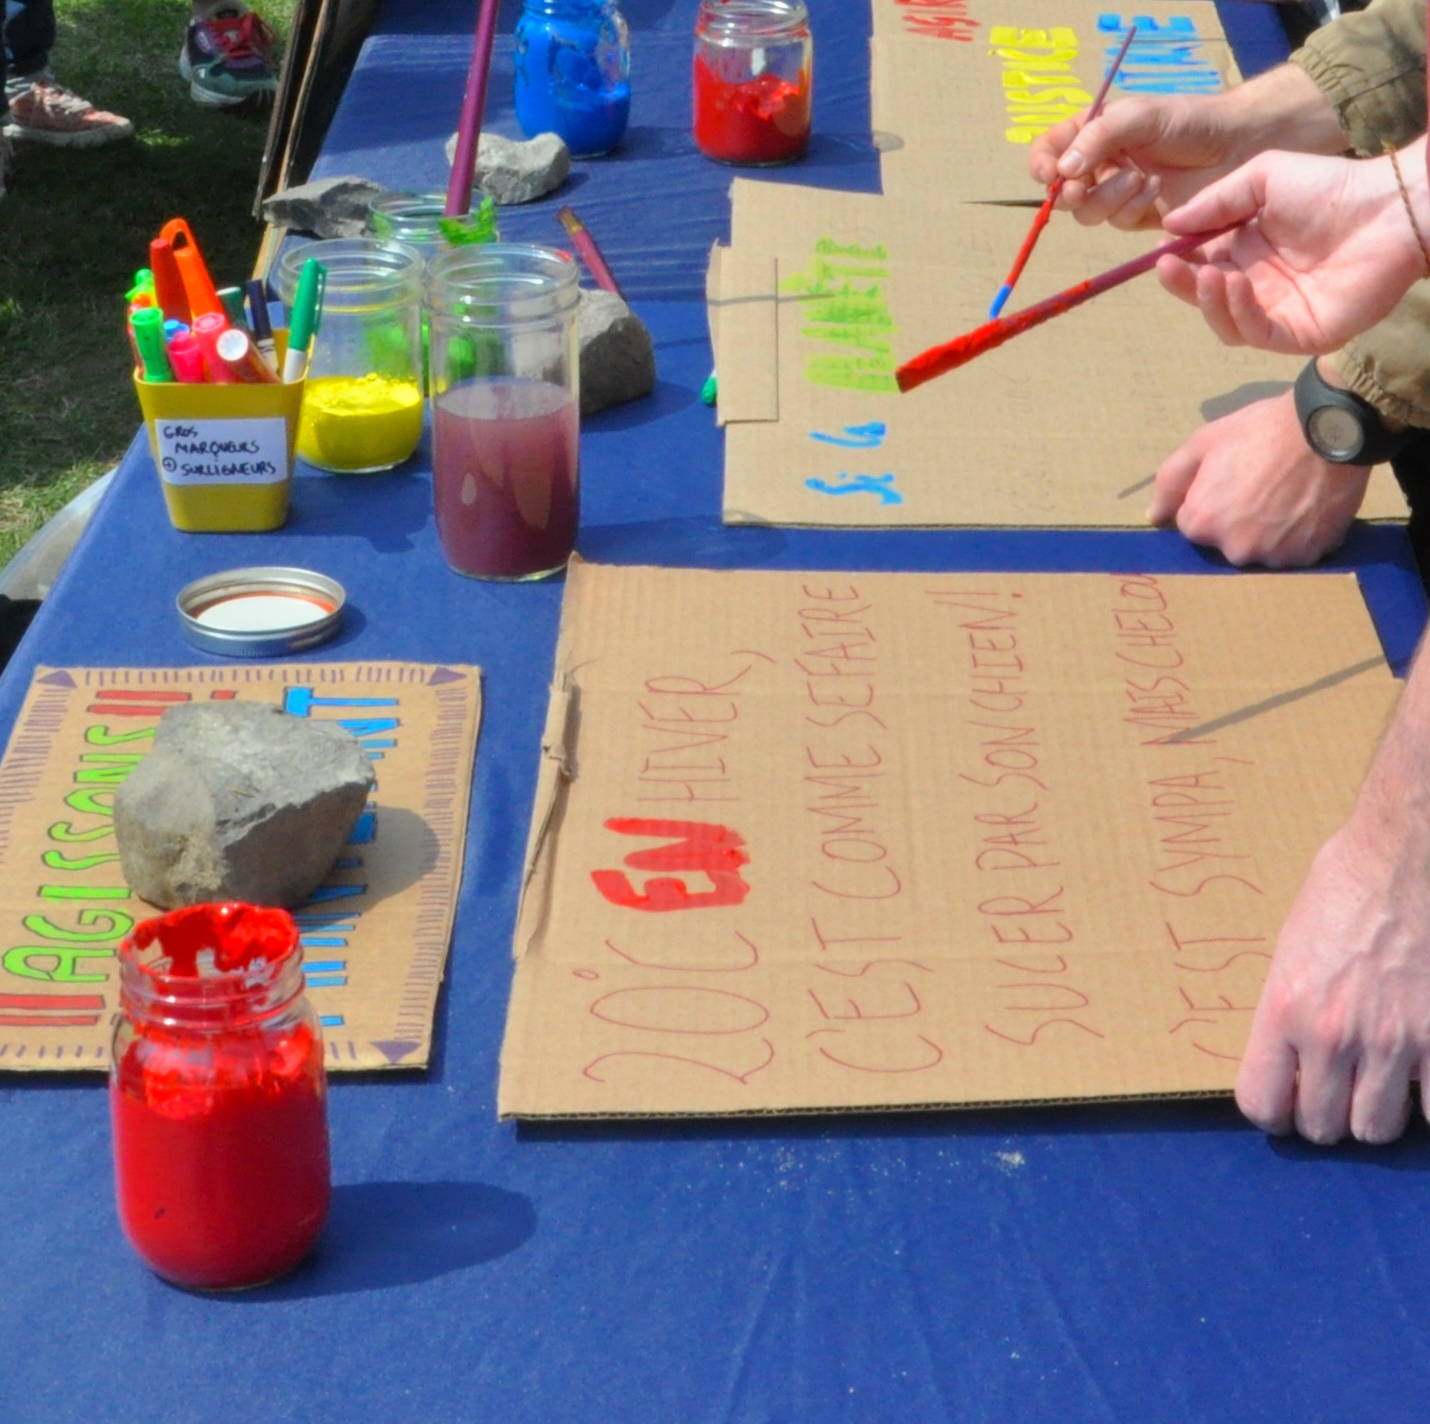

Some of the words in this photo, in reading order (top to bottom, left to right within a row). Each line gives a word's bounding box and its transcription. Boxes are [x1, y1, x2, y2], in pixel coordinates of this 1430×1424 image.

[163, 425, 198, 439] GROS
[175, 440, 260, 459] MARQUEURS
[180, 460, 277, 476] SURLIGNEURS
[1123, 677, 1219, 746] MAIS
[958, 720, 1049, 791] SON
[804, 744, 902, 901] COMME
[974, 802, 1061, 871] PAR
[590, 816, 751, 913] EN
[806, 917, 944, 1074] C'EST
[977, 884, 1106, 1047] SUCER
